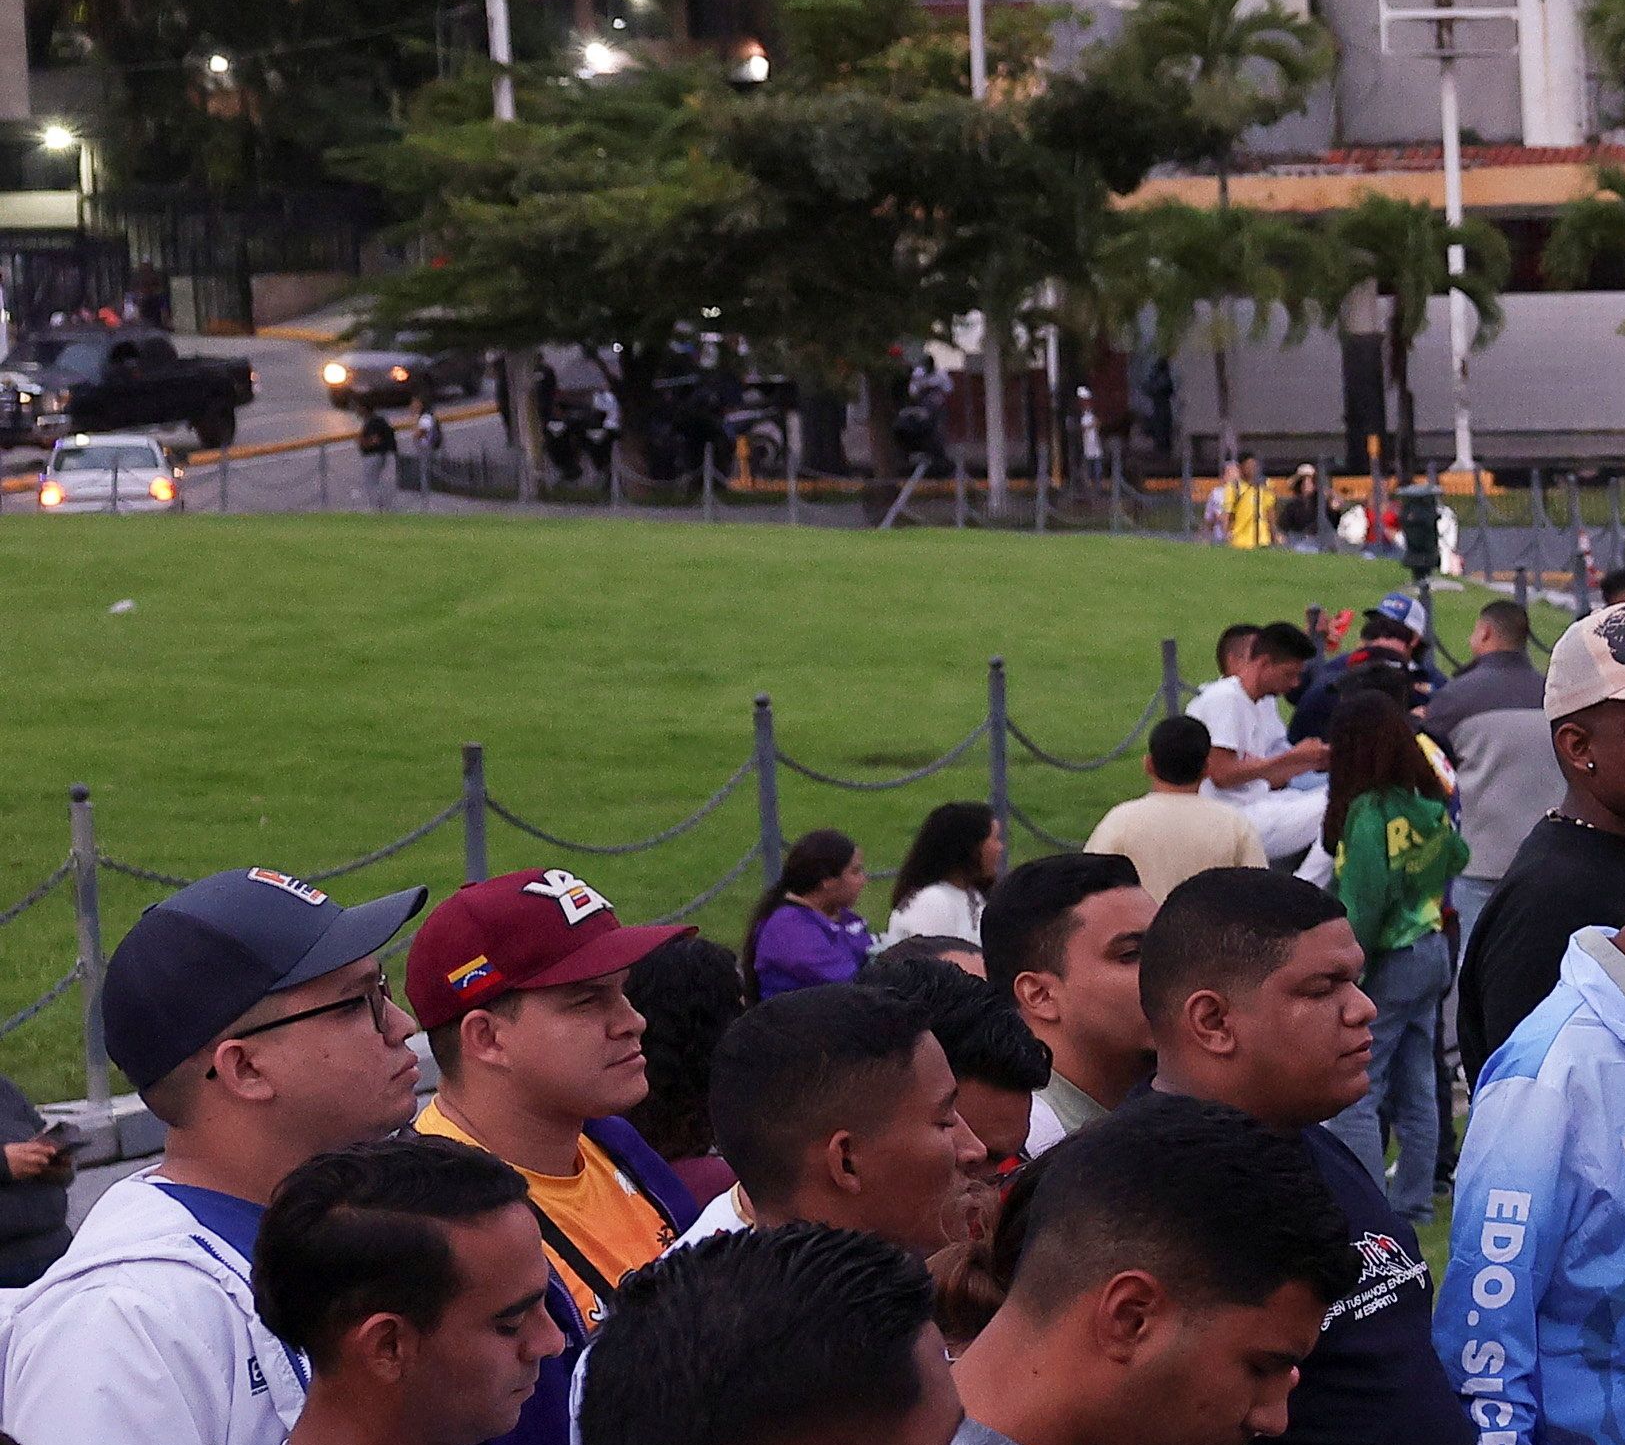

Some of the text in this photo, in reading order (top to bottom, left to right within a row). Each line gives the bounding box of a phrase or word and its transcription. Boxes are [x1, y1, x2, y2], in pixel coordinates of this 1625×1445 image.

[1345, 1293, 1362, 1310] TUS
[1361, 1282, 1388, 1304] MANOS
[1466, 1188, 1533, 1327] EDO.
